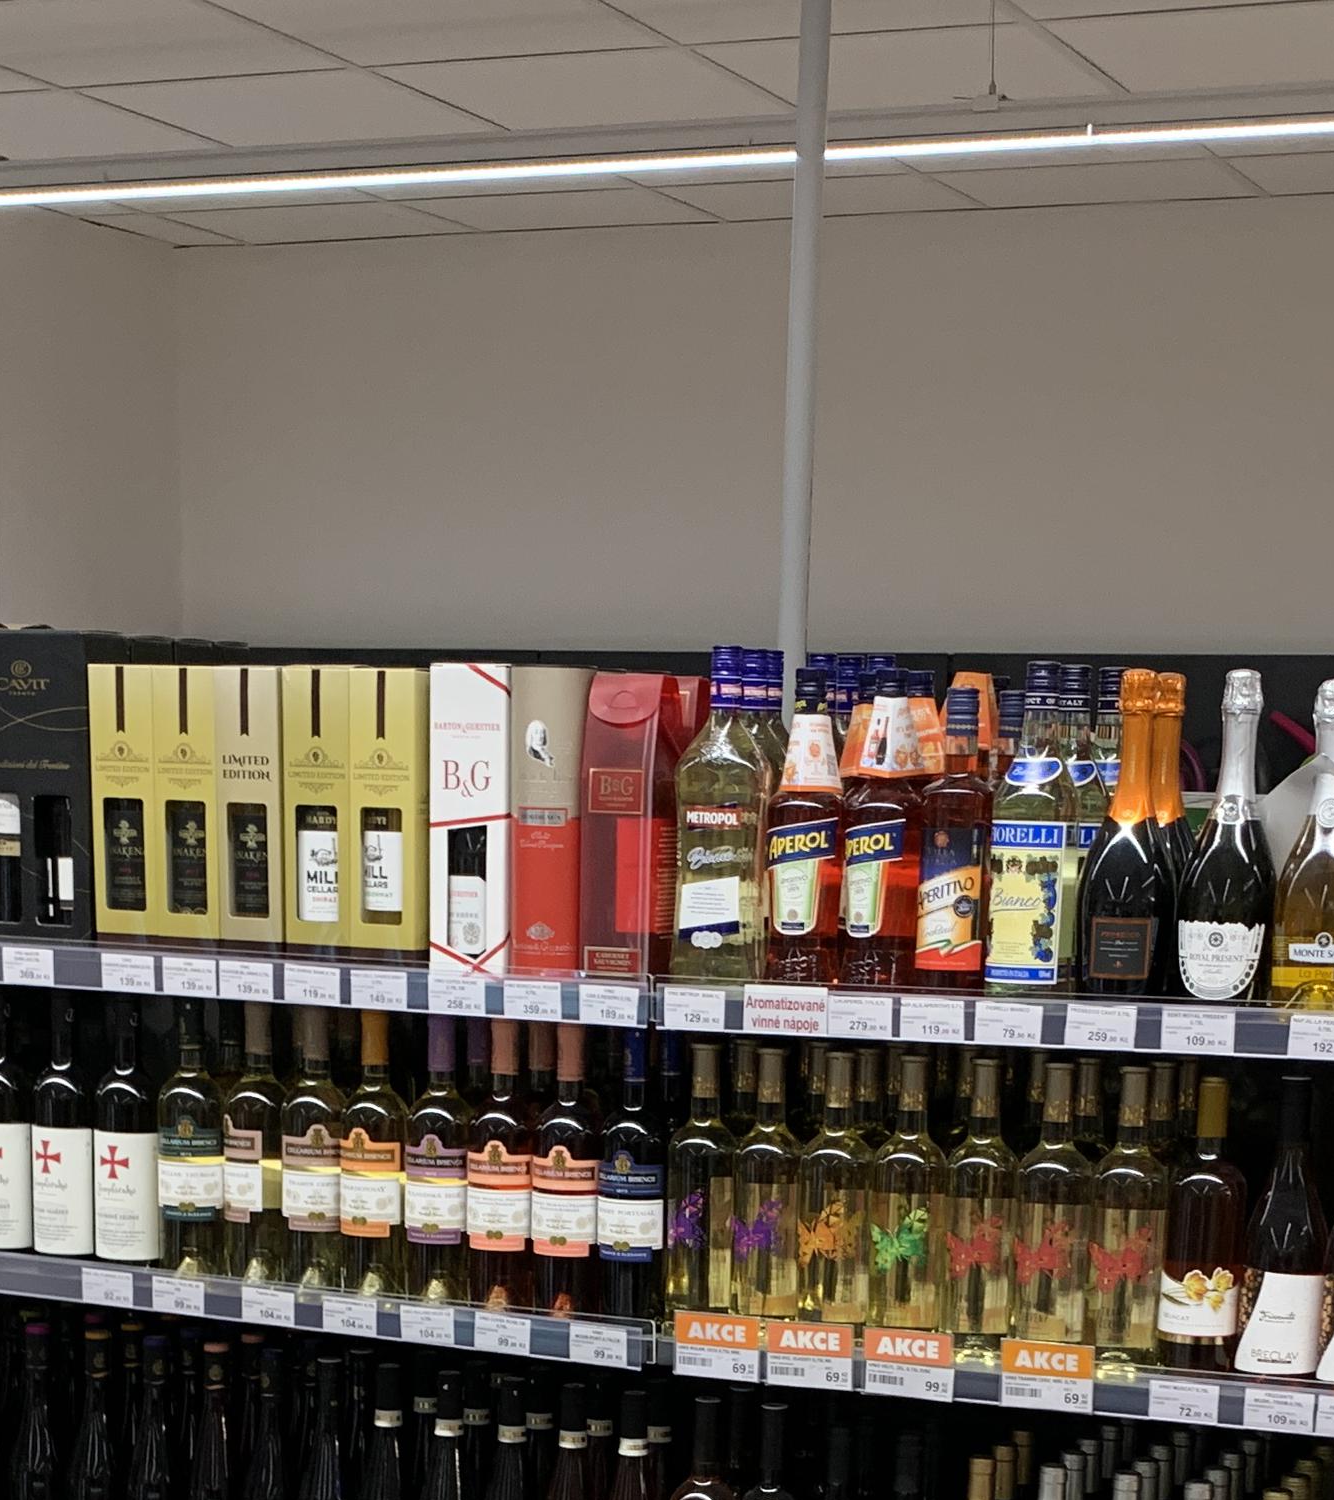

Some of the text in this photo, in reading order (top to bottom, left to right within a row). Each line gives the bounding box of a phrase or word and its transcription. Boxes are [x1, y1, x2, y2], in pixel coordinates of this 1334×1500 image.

[222, 754, 270, 766] LIMITED
[222, 768, 273, 782] EDITION
[442, 760, 491, 799] B&G
[686, 809, 739, 826] METROPOL
[769, 832, 829, 861] APEROL
[917, 876, 974, 908] APERITIVO
[992, 887, 1043, 908] Bianco
[1293, 947, 1325, 959] MONTE
[746, 995, 826, 1012] Aromatizované
[751, 1015, 820, 1032] vinné nápoje
[688, 1321, 746, 1343] AKCE
[779, 1329, 841, 1351] AKCE
[877, 1336, 940, 1360] AKCE
[1015, 1349, 1079, 1372] AKCE
